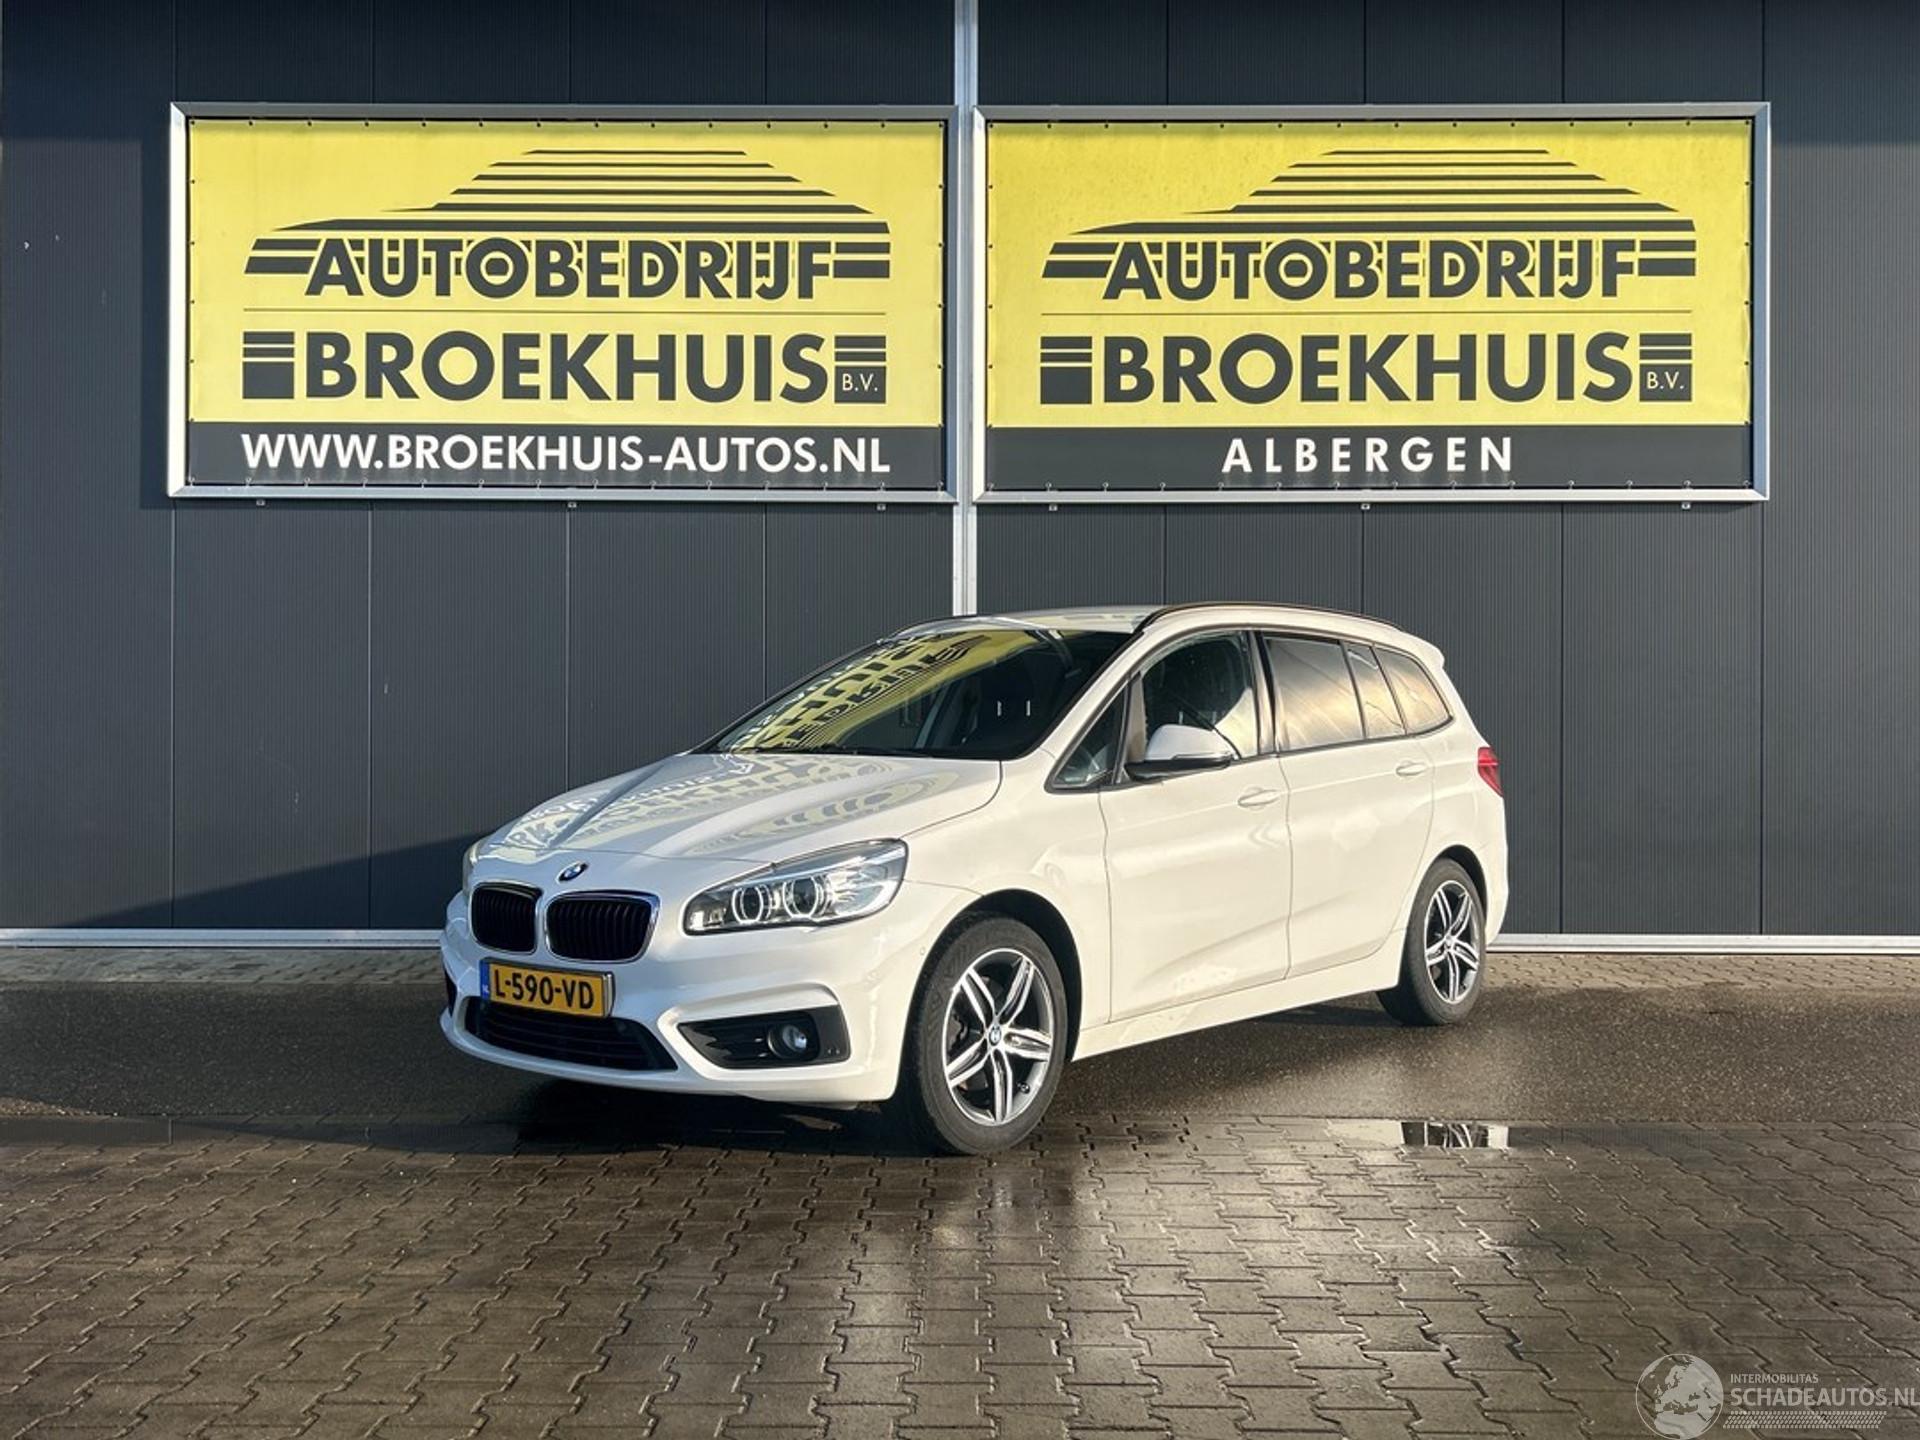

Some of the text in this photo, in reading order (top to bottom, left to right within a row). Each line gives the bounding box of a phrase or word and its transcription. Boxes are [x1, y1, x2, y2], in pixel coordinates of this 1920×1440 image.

[305, 237, 833, 300] AUTOBEDRIJF
[1103, 238, 1637, 301] AUTOBEDRIJF
[305, 330, 879, 402] BROEKHUIS B.V.
[1104, 332, 1685, 404] BROEKHUIS B.V.
[241, 433, 890, 474] WWW.BROEKHUIS-AUTOS.NL
[1222, 436, 1513, 474] ALBERGEN
[494, 969, 595, 1010] L-590-VD
